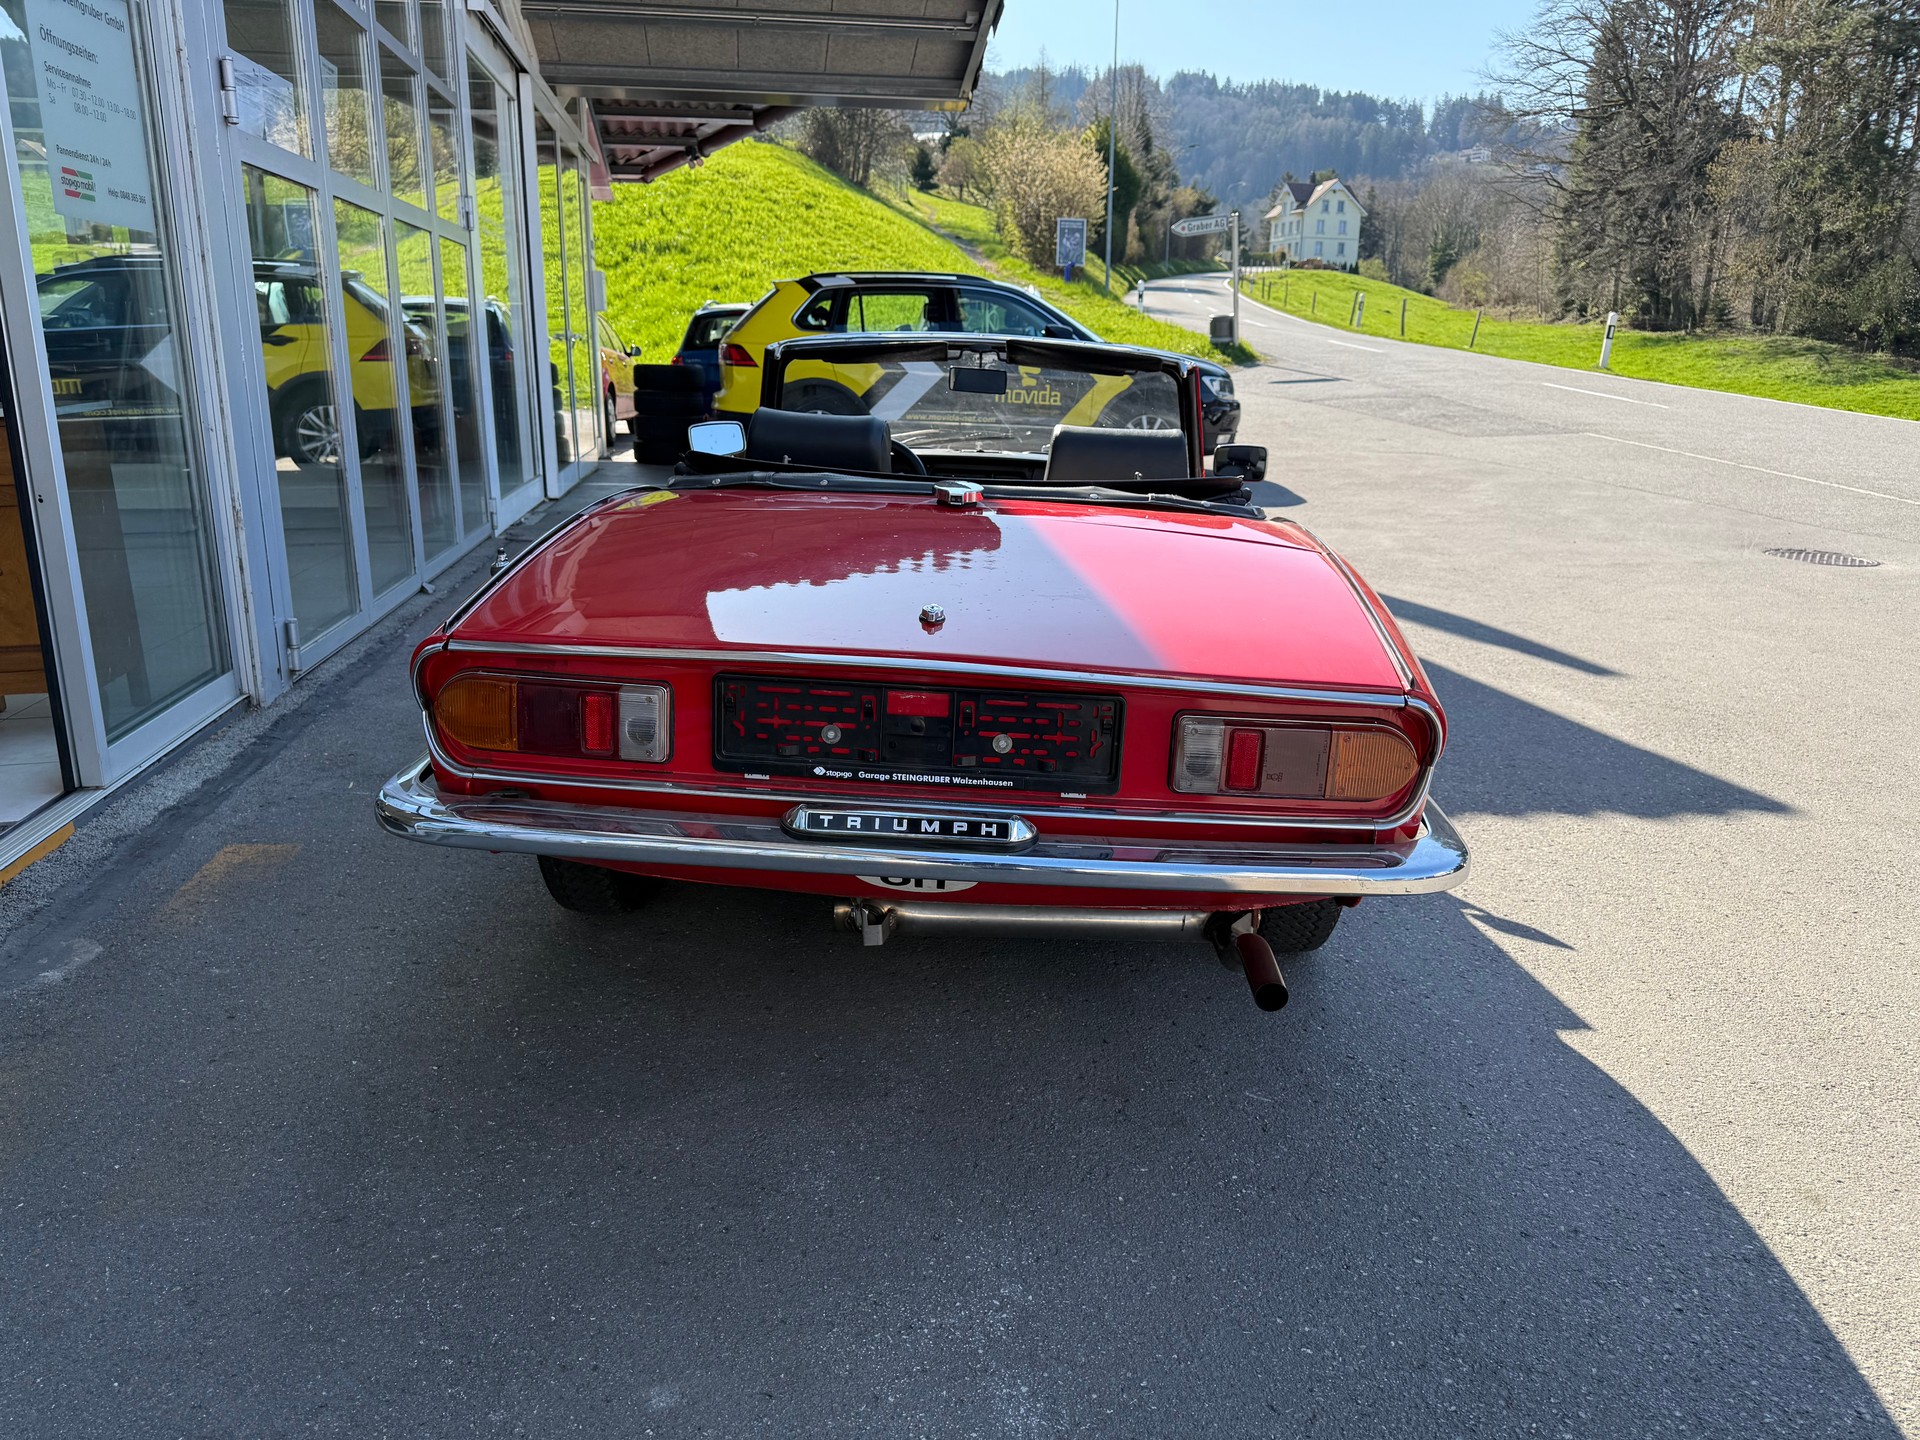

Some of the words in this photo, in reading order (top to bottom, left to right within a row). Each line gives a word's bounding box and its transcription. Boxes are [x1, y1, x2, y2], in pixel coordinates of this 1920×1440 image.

[62, 0, 103, 22] eingruber
[104, 12, 125, 33] GmbH
[39, 23, 99, 64] Öffnungszeiten:
[43, 60, 92, 89] Serviceannahme
[56, 144, 89, 162] Pannendienst
[1187, 221, 1213, 232] Graber
[1214, 219, 1225, 228] AG
[995, 384, 1062, 406] movida
[905, 413, 997, 424] www.movida-net.com
[858, 771, 890, 781] Garage
[892, 773, 951, 783] STEINGRUBER
[952, 776, 1014, 787] Walzenhausen
[819, 815, 998, 836] TRIUMPH
